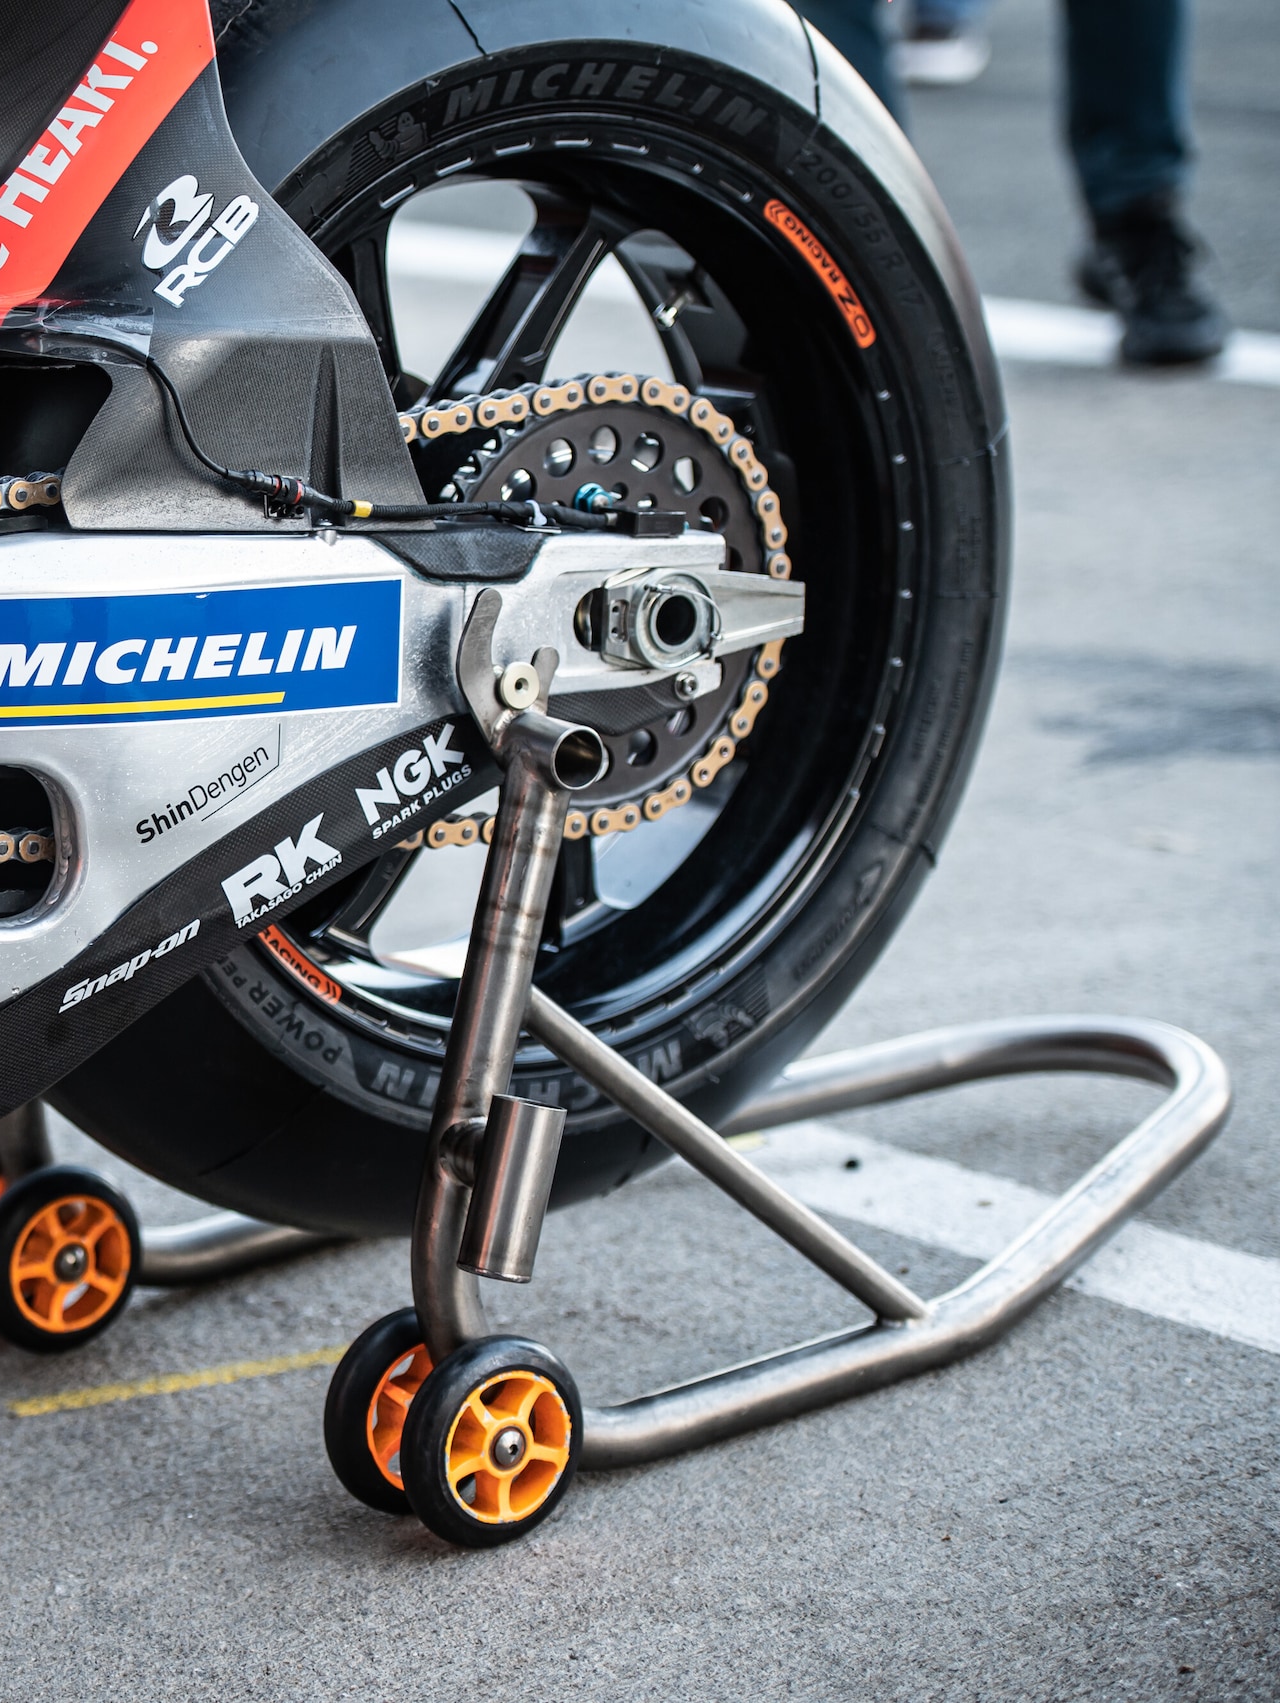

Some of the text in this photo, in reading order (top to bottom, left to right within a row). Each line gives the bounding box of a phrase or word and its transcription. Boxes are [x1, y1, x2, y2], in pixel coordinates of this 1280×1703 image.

[441, 62, 768, 137] MICHELIN
[152, 194, 260, 308] RCB
[784, 215, 871, 338] OZ RACING
[135, 746, 269, 844] ShinDengen
[354, 722, 465, 826] NGK
[372, 764, 472, 839] SPARK PLUGS
[220, 811, 341, 922] RK
[234, 853, 343, 929] TAKASAGO CHAIN
[249, 980, 345, 1066] POWER
